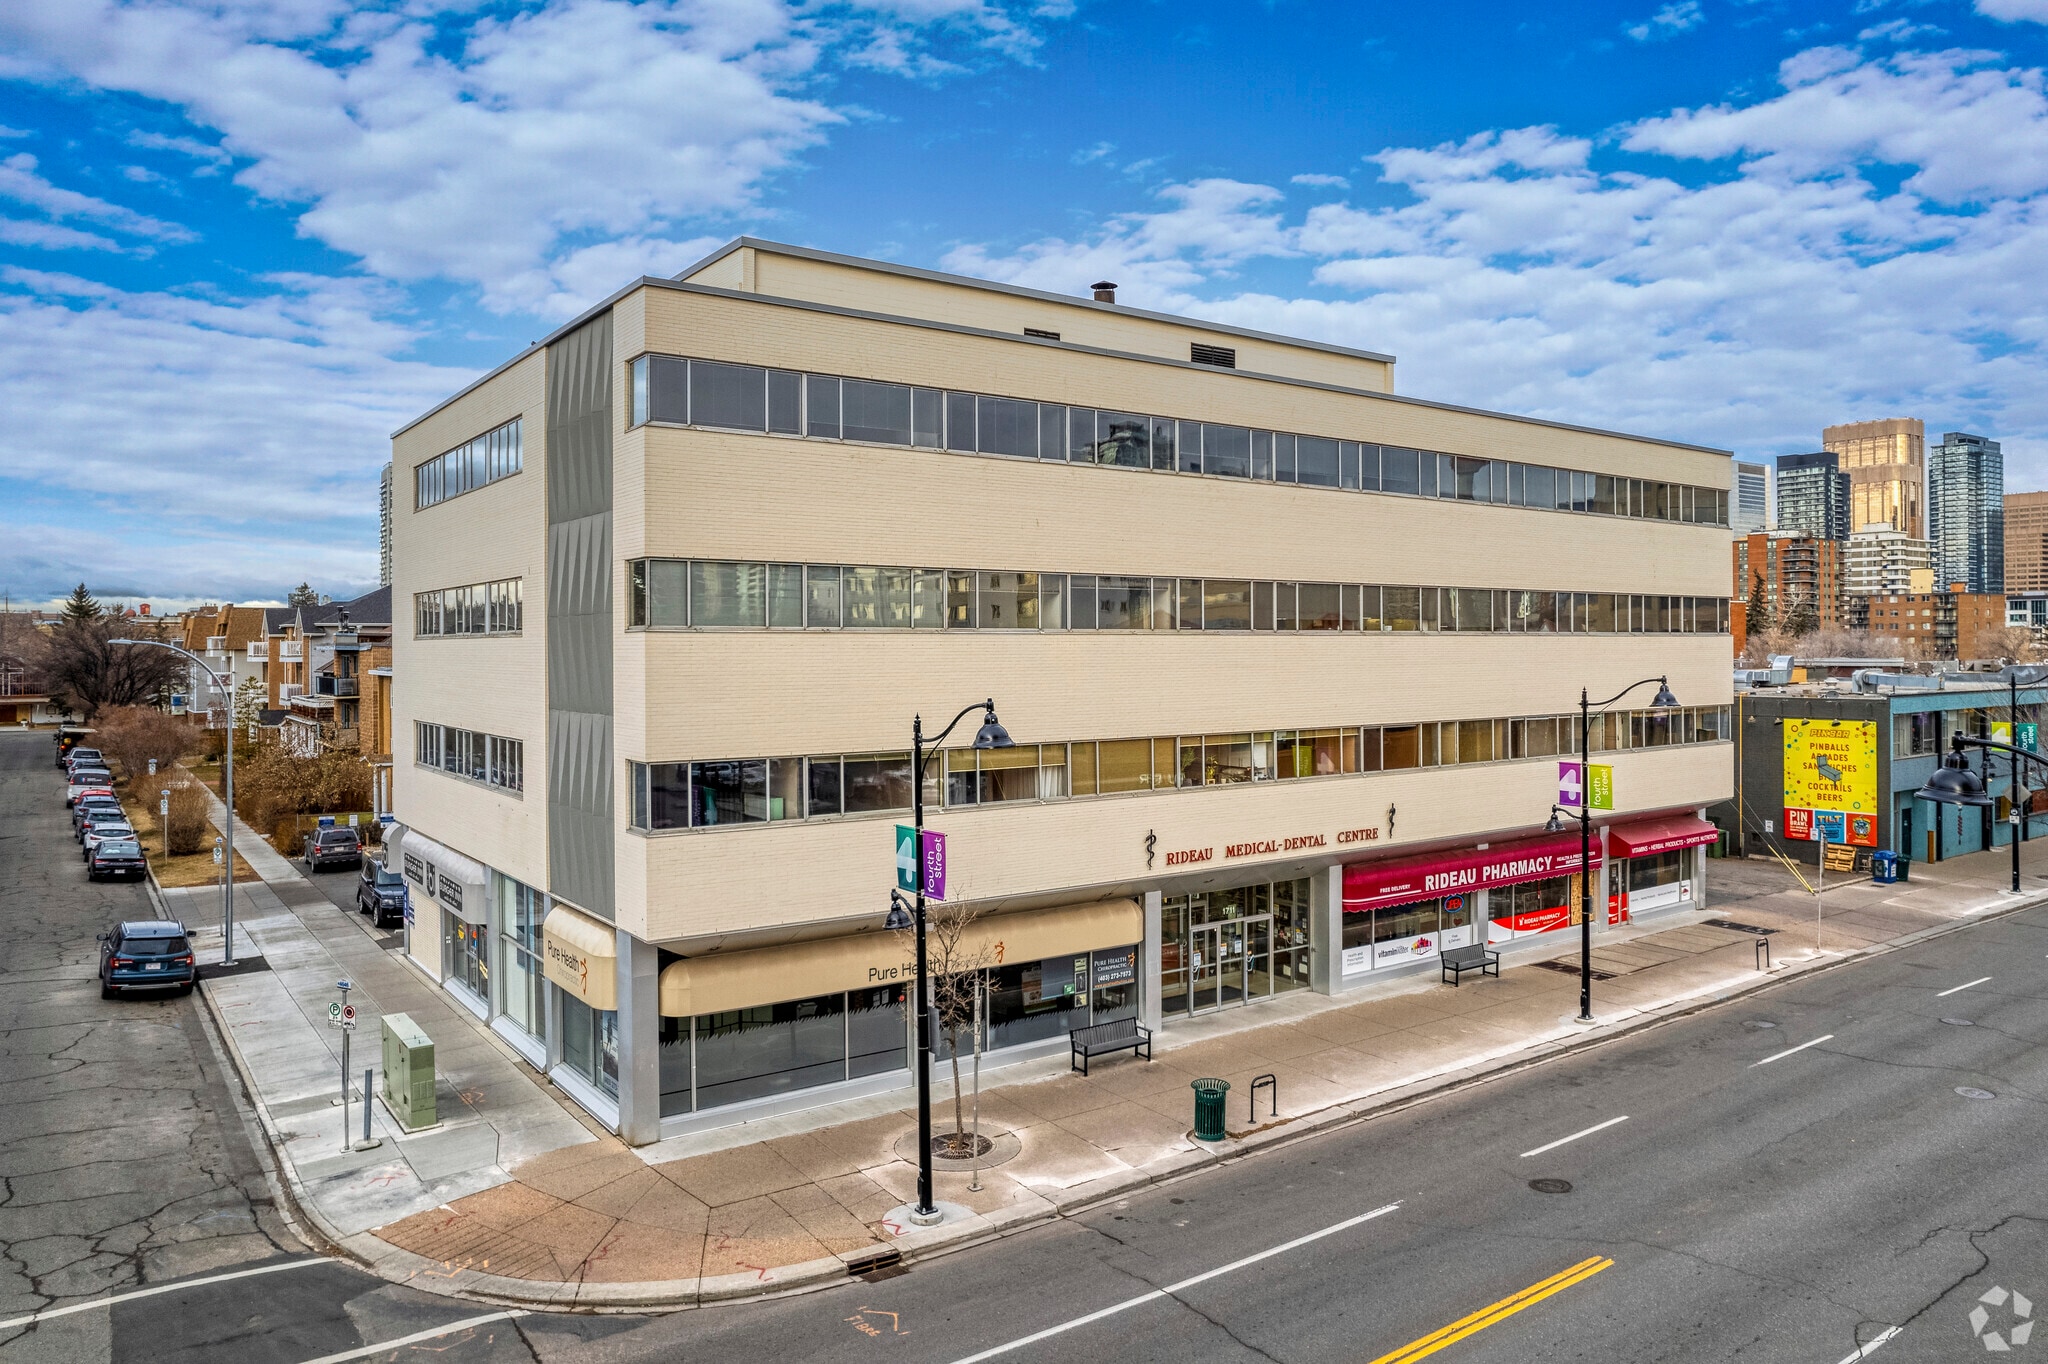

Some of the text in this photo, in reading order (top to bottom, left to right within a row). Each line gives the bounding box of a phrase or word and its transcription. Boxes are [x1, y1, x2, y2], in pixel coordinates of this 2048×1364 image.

[1810, 743, 1850, 751] PINBALLS
[1808, 783, 1852, 792] COCKTAILS
[1817, 793, 1843, 802] BEERS
[1790, 810, 1808, 822] PIN
[1817, 815, 1842, 823] TILT
[1166, 828, 1379, 866] RIDEAU MEDICAL-DENTAL CENTRE
[1651, 843, 1665, 851] HERBAL
[1665, 840, 1684, 848] PRODUCTS
[1686, 836, 1700, 845] SPORTS
[934, 837, 942, 879] street
[927, 850, 935, 893] fourth
[1425, 856, 1553, 891] RIDEAU PHARMACY
[1391, 884, 1411, 892] DELIVERY
[1223, 906, 1235, 915] 1711
[1524, 917, 1538, 925] RIDEAU
[1540, 912, 1560, 921] PHARMACY
[547, 940, 579, 973] Pure Health
[1094, 956, 1127, 968] PURE HEALTH
[1097, 962, 1127, 972] CHIROPRACTIC
[868, 967, 898, 982] Pure
[1097, 974, 1110, 983] (403)
